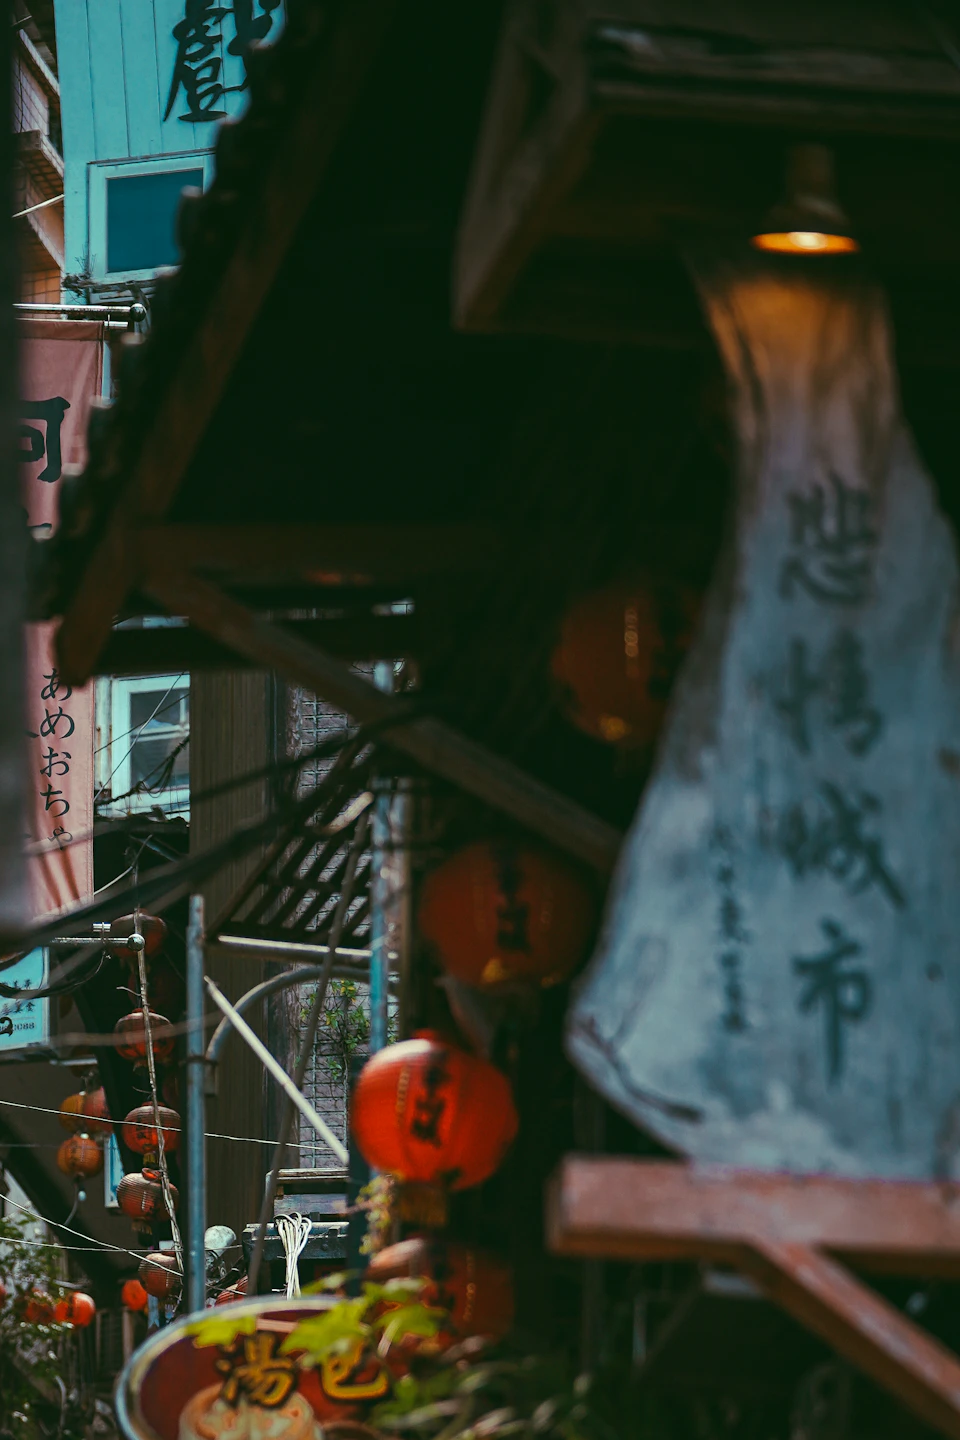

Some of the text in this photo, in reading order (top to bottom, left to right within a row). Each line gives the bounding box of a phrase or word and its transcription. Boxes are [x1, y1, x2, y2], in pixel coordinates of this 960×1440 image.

[40, 667, 75, 850] あめおちゃ
[214, 1332, 391, 1408] 湯包
